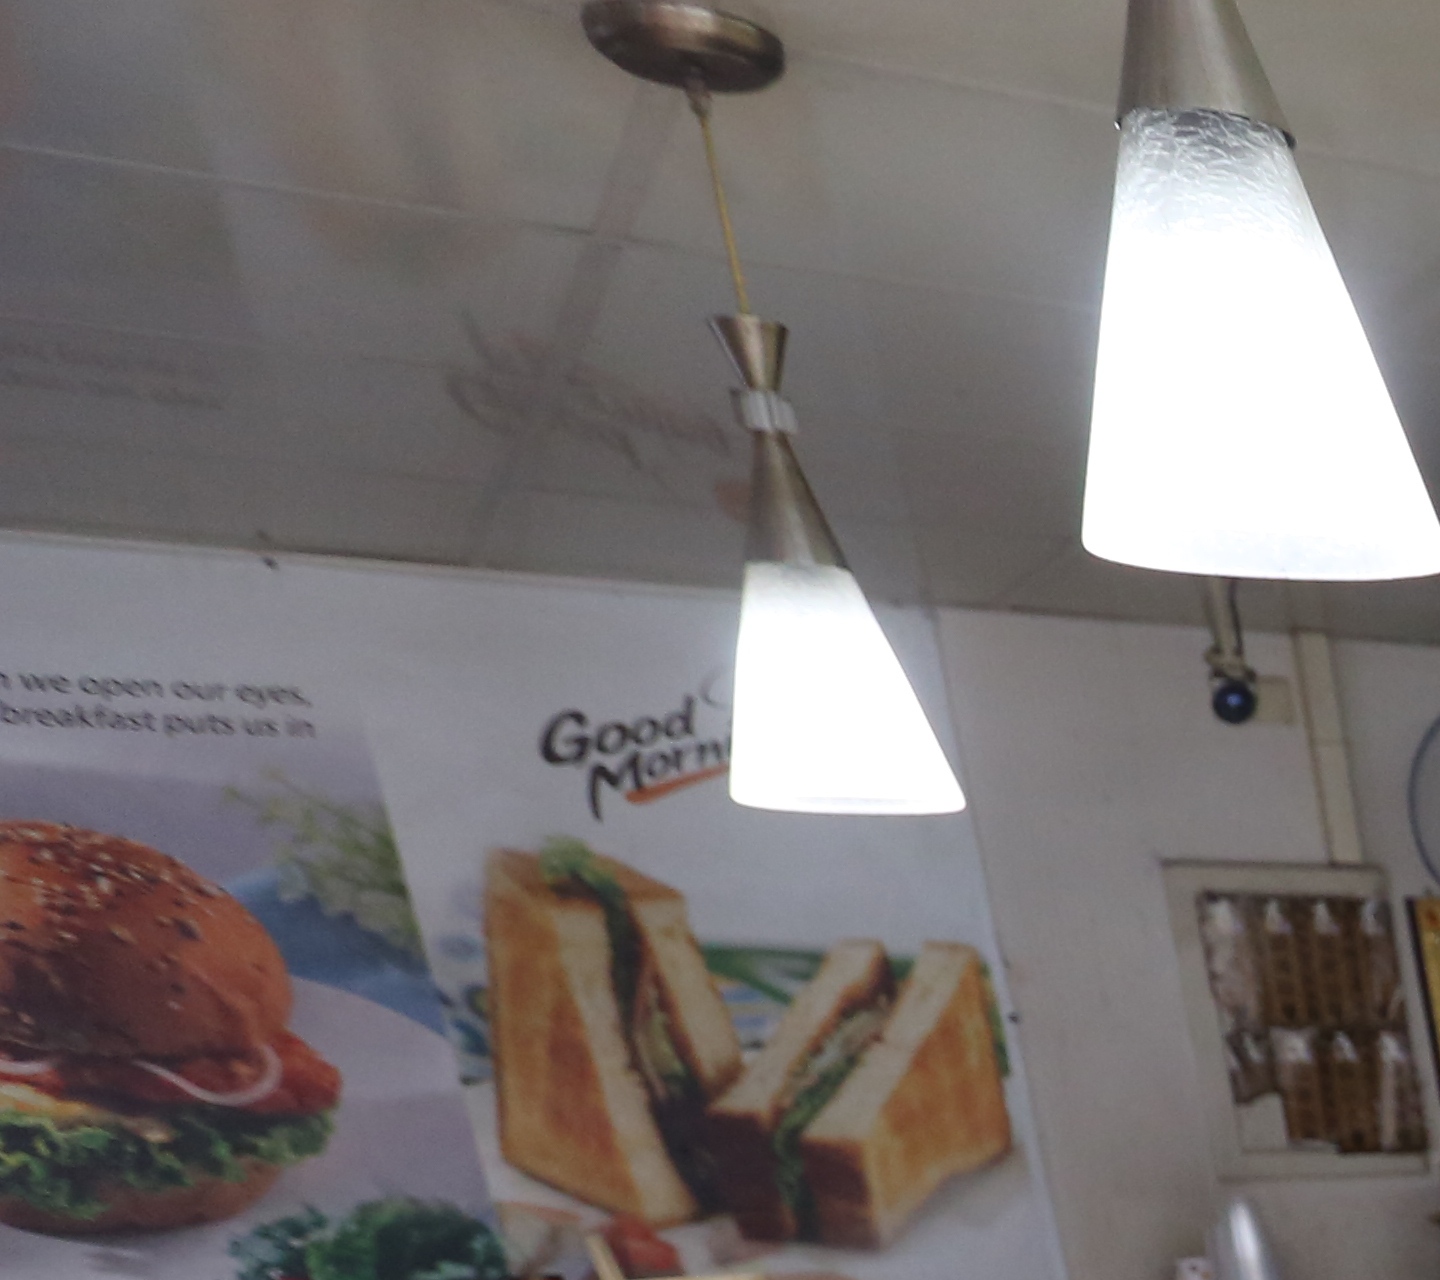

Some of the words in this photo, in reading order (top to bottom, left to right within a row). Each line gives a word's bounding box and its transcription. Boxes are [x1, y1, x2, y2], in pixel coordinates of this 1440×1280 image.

[19, 673, 70, 696] we
[78, 676, 164, 702] open
[171, 680, 226, 701] our
[0, 699, 156, 732] breakfast
[164, 713, 235, 739] puts
[242, 719, 280, 738] us
[286, 714, 316, 738] in
[541, 696, 696, 768] Good
